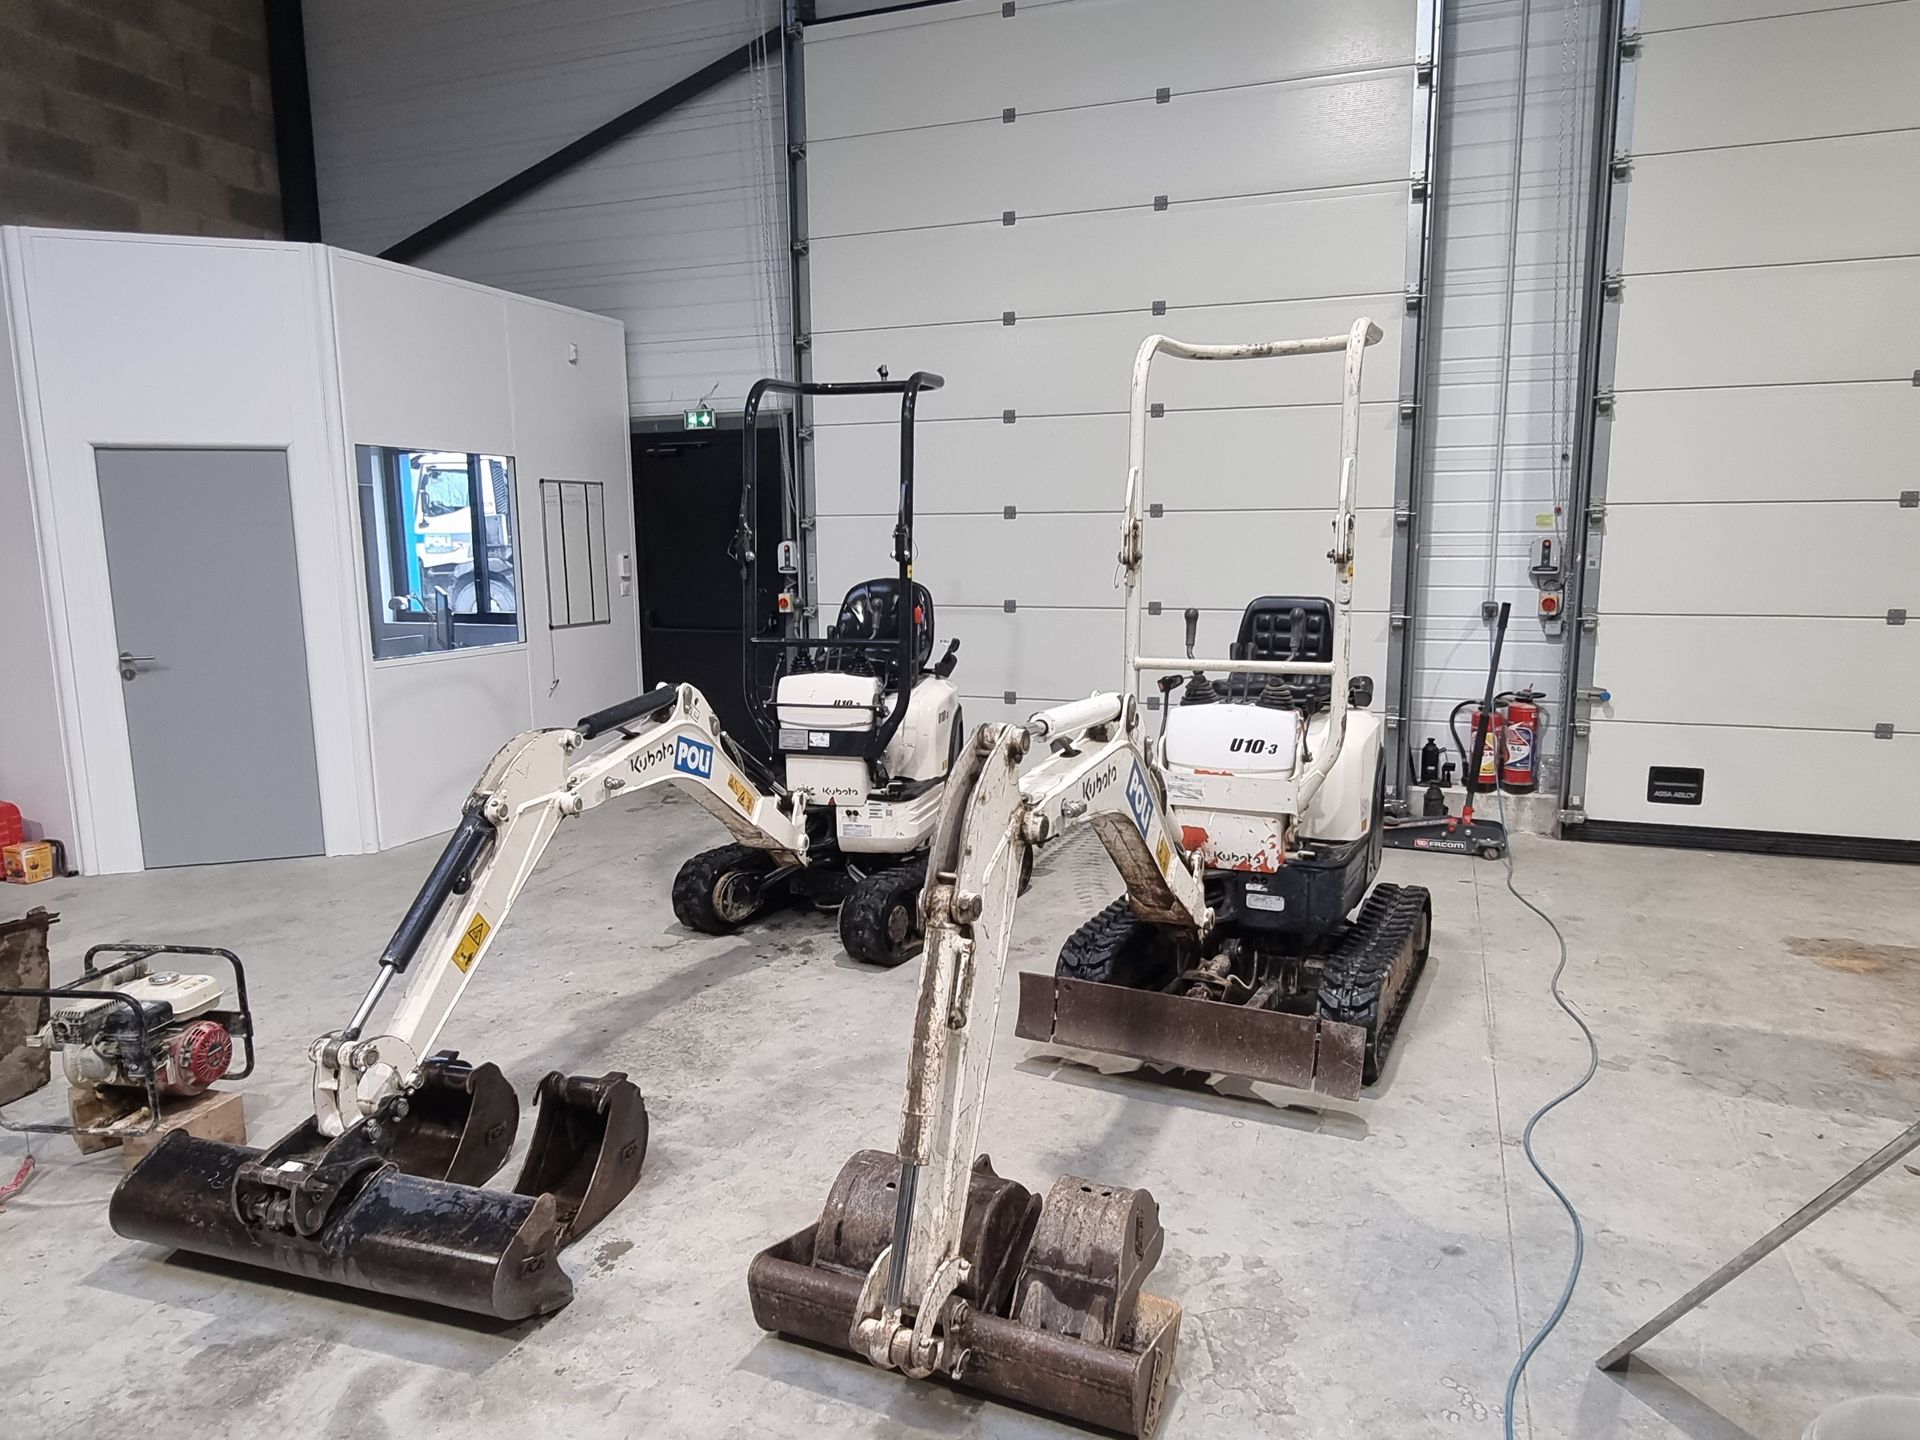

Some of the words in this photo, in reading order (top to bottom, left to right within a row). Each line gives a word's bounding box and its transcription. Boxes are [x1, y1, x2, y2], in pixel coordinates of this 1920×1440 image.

[1229, 738, 1278, 755] U10-3
[630, 742, 674, 773] Kubota
[1082, 764, 1117, 801] Kubota
[822, 787, 859, 796] Kubota
[1214, 851, 1261, 864] Kubota
